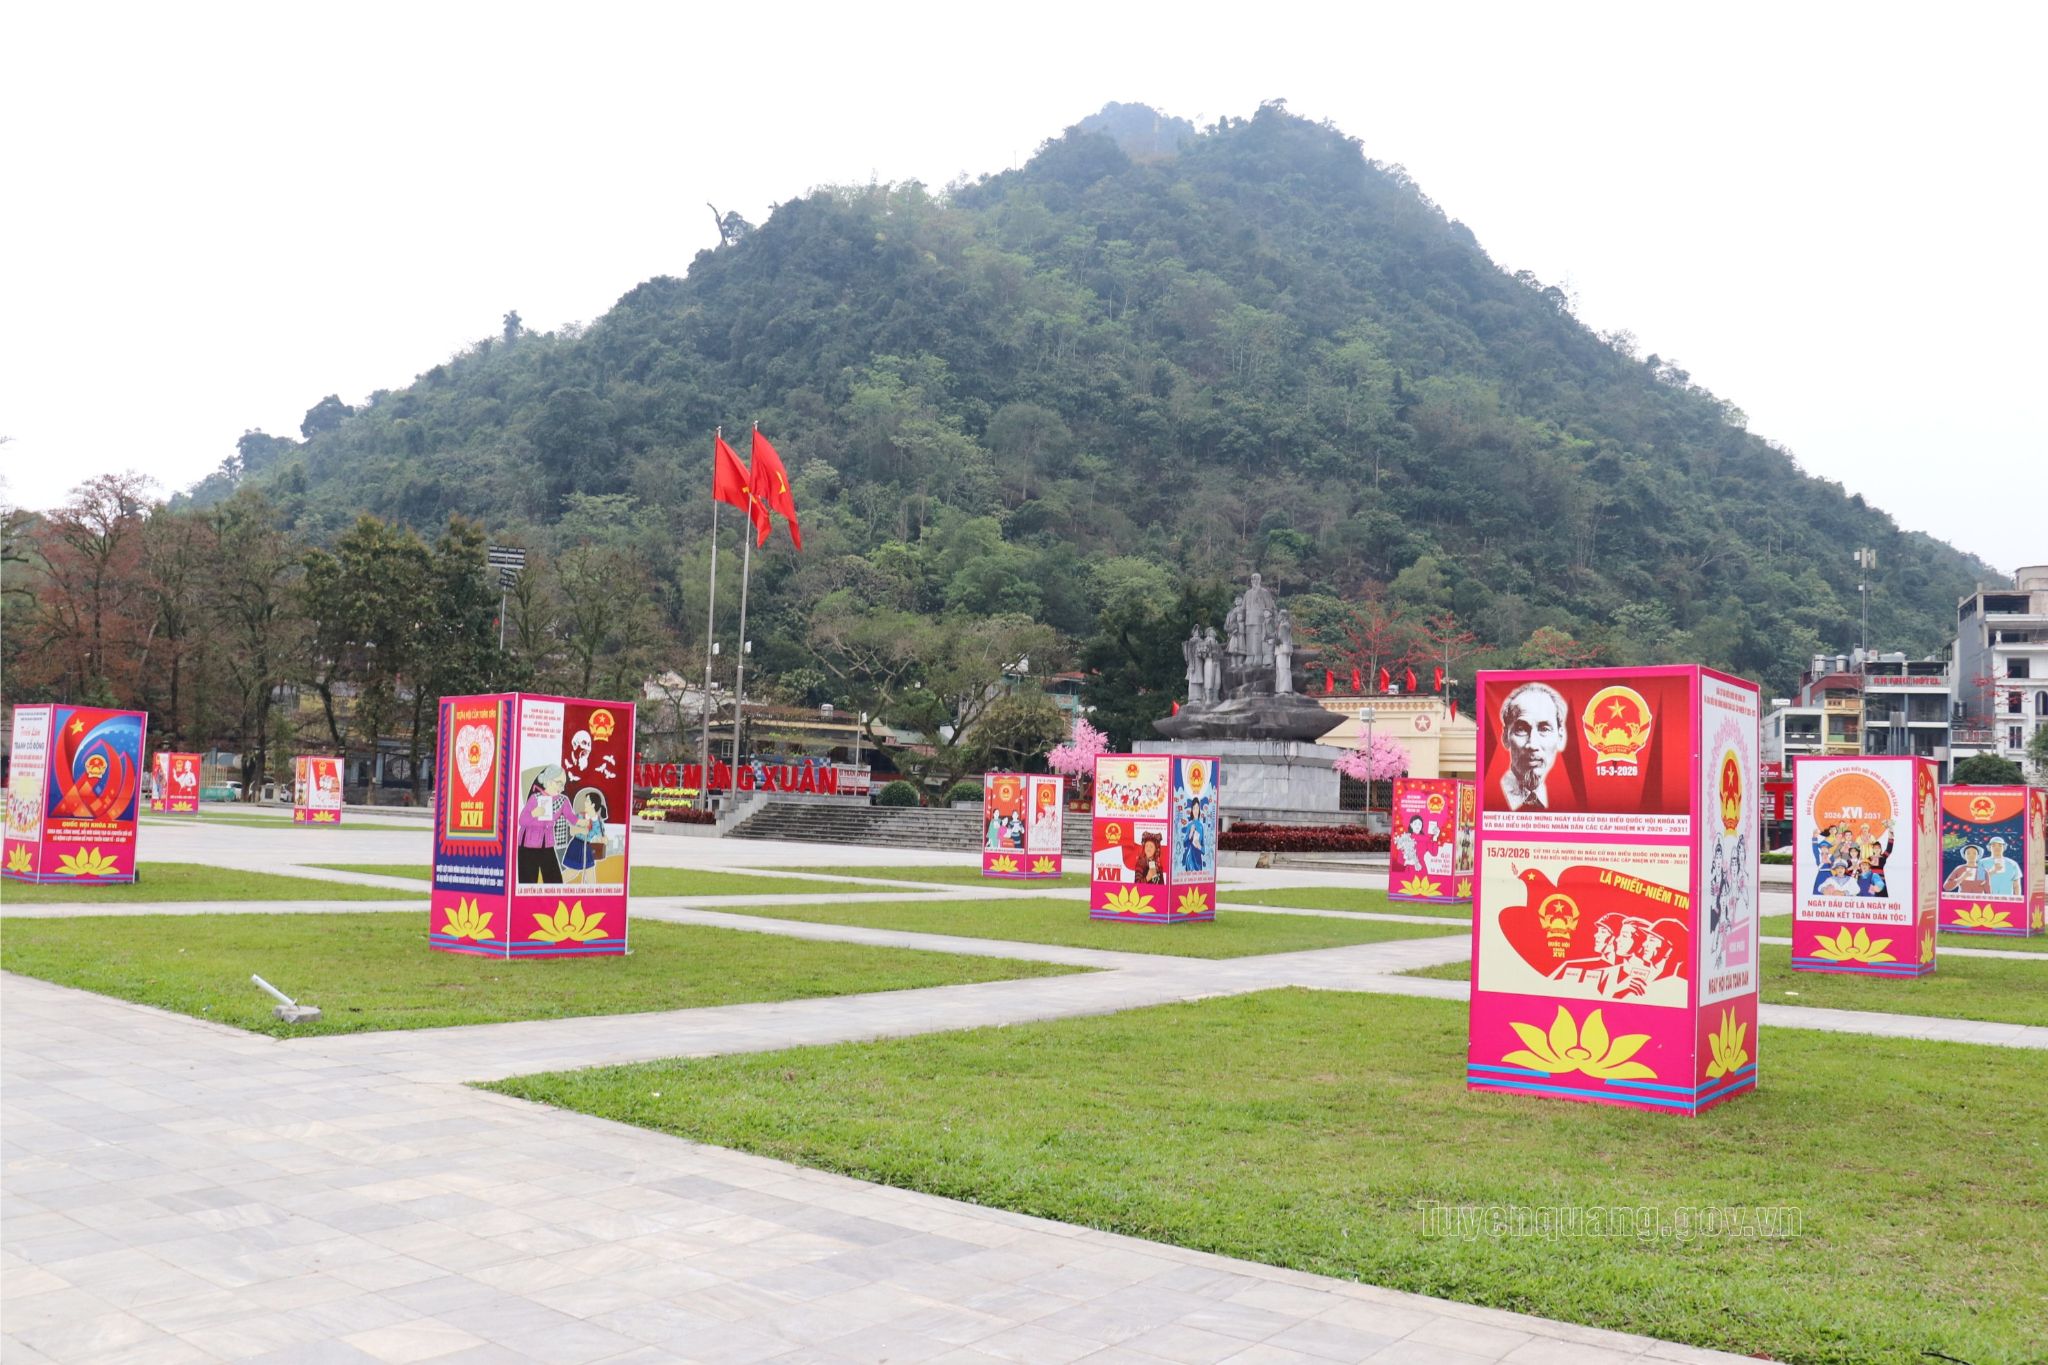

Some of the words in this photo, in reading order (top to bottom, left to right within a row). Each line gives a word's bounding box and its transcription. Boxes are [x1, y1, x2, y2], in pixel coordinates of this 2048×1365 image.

[634, 752, 677, 788] ẢNG
[683, 754, 755, 790] MỪNG
[761, 759, 838, 795] XUÂN
[1596, 766, 1638, 776] 15-3-2026
[460, 810, 484, 827] XVI
[1842, 806, 1863, 819] XVI
[1487, 847, 1530, 858] 15/3/2026
[1097, 868, 1121, 881] XVI
[1600, 870, 1613, 885] LÁ
[1674, 894, 1689, 910] TIN
[1867, 902, 1886, 910] NGÀY
